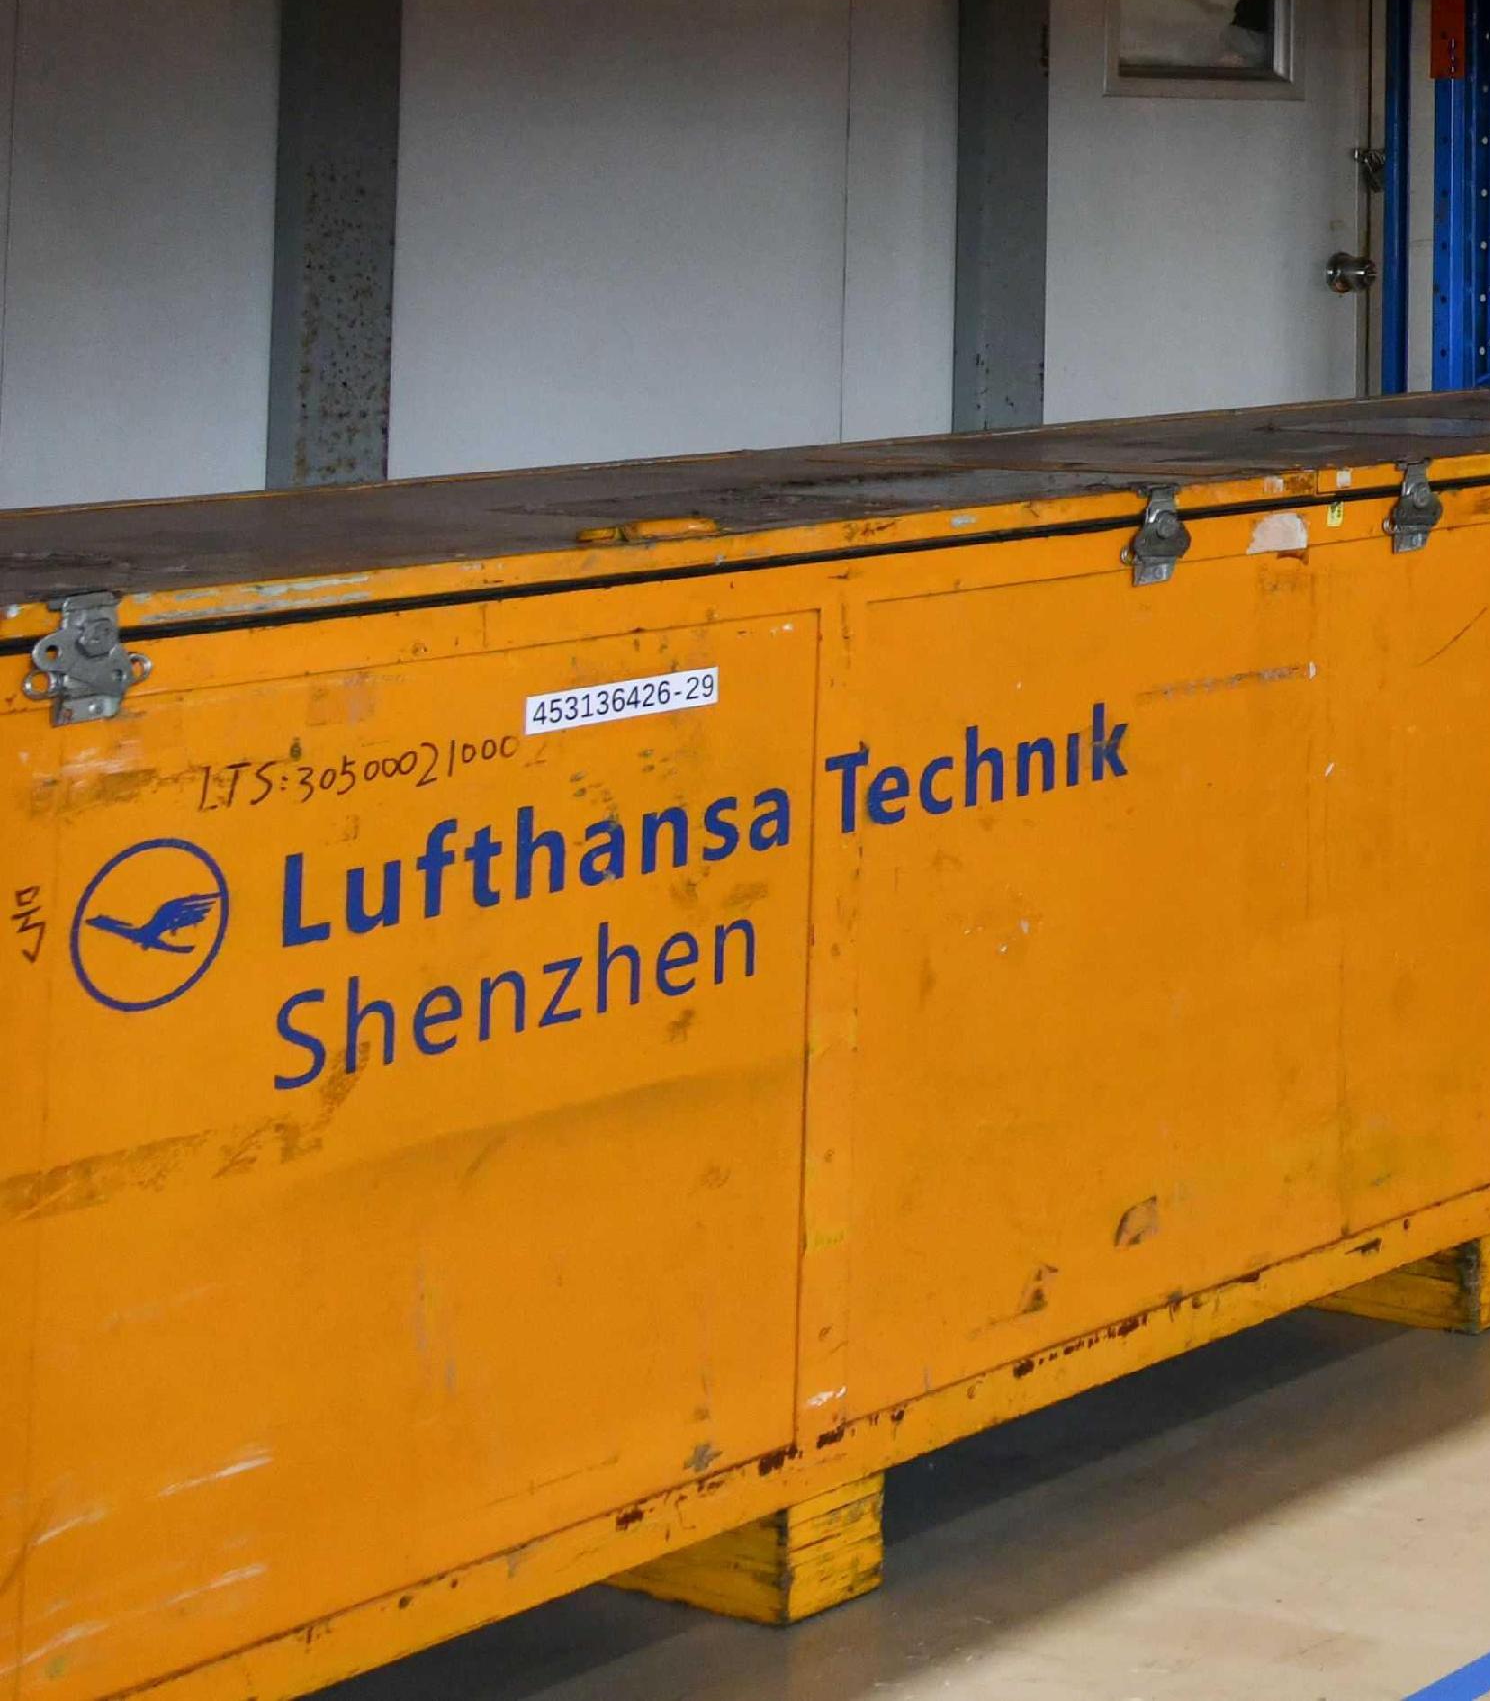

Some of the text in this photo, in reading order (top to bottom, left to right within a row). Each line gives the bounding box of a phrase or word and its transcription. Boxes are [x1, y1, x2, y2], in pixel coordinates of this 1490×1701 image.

[532, 672, 715, 726] 453136426-29
[282, 702, 1129, 947] Lufthansa Technik
[273, 917, 756, 1090] Shenzhen
